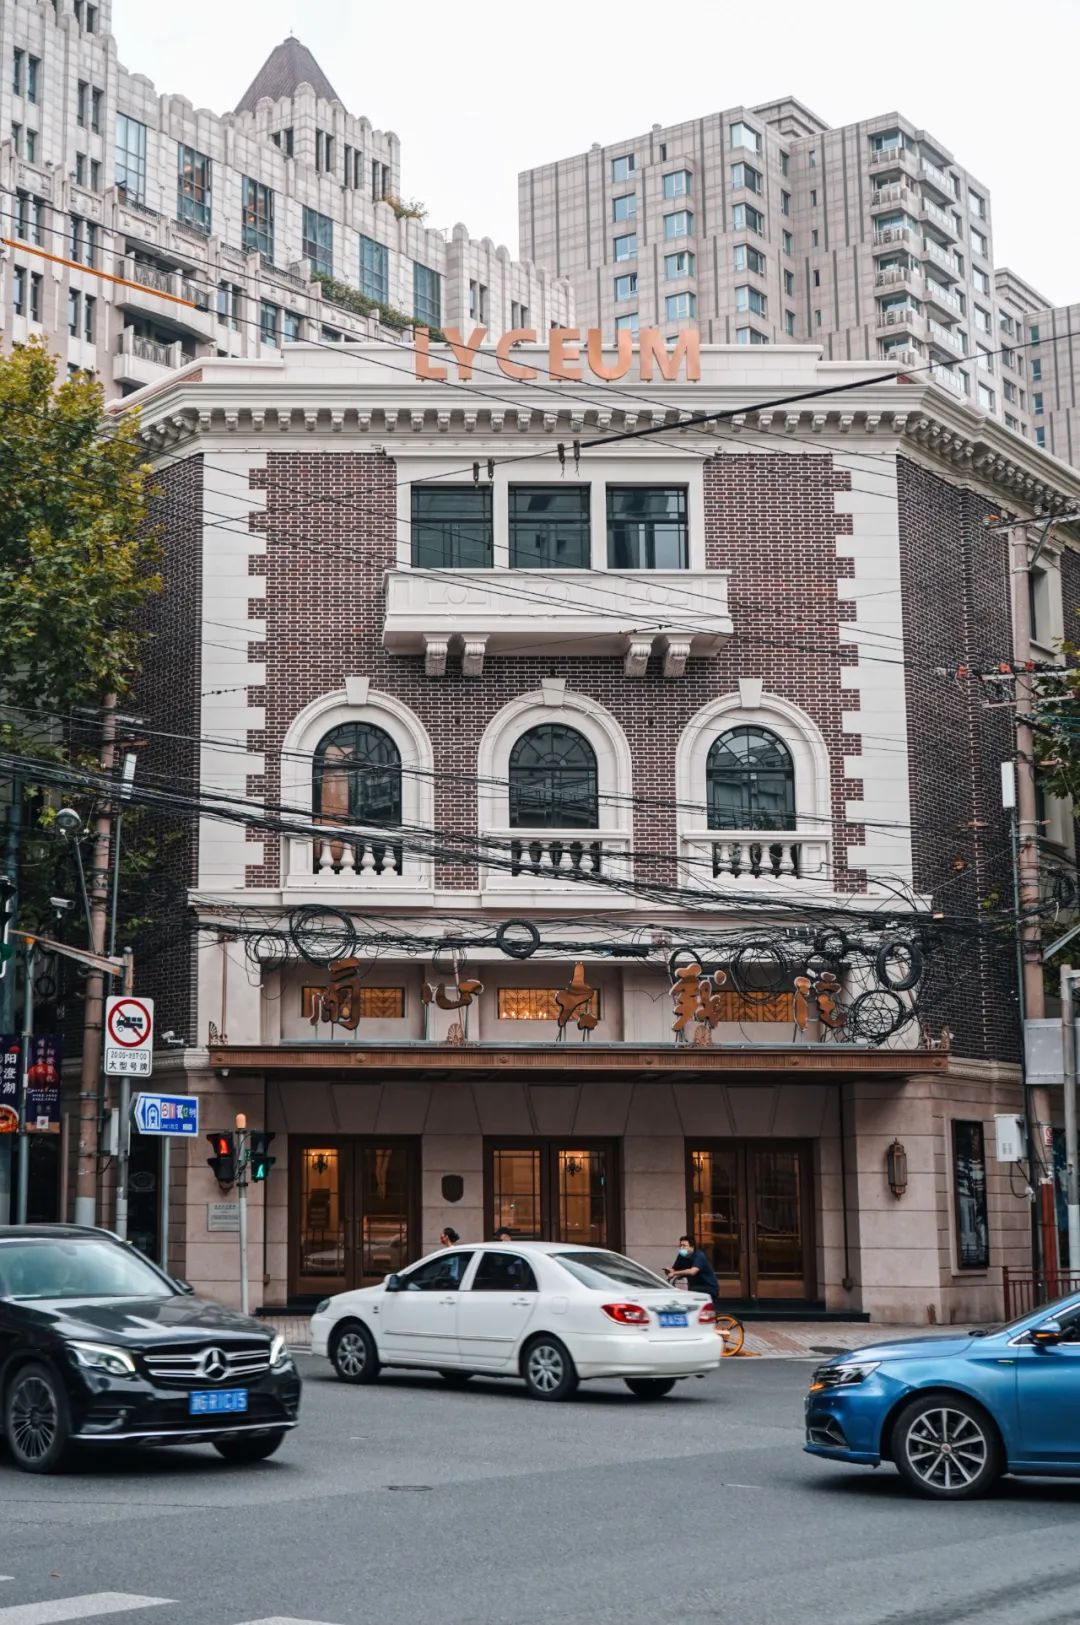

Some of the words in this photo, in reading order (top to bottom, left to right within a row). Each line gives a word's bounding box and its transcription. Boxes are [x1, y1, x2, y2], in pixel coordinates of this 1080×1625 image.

[414, 327, 700, 381] LYCEUM
[3, 1053, 17, 1094] 阳澄湖
[109, 1061, 148, 1071] 大型号牌
